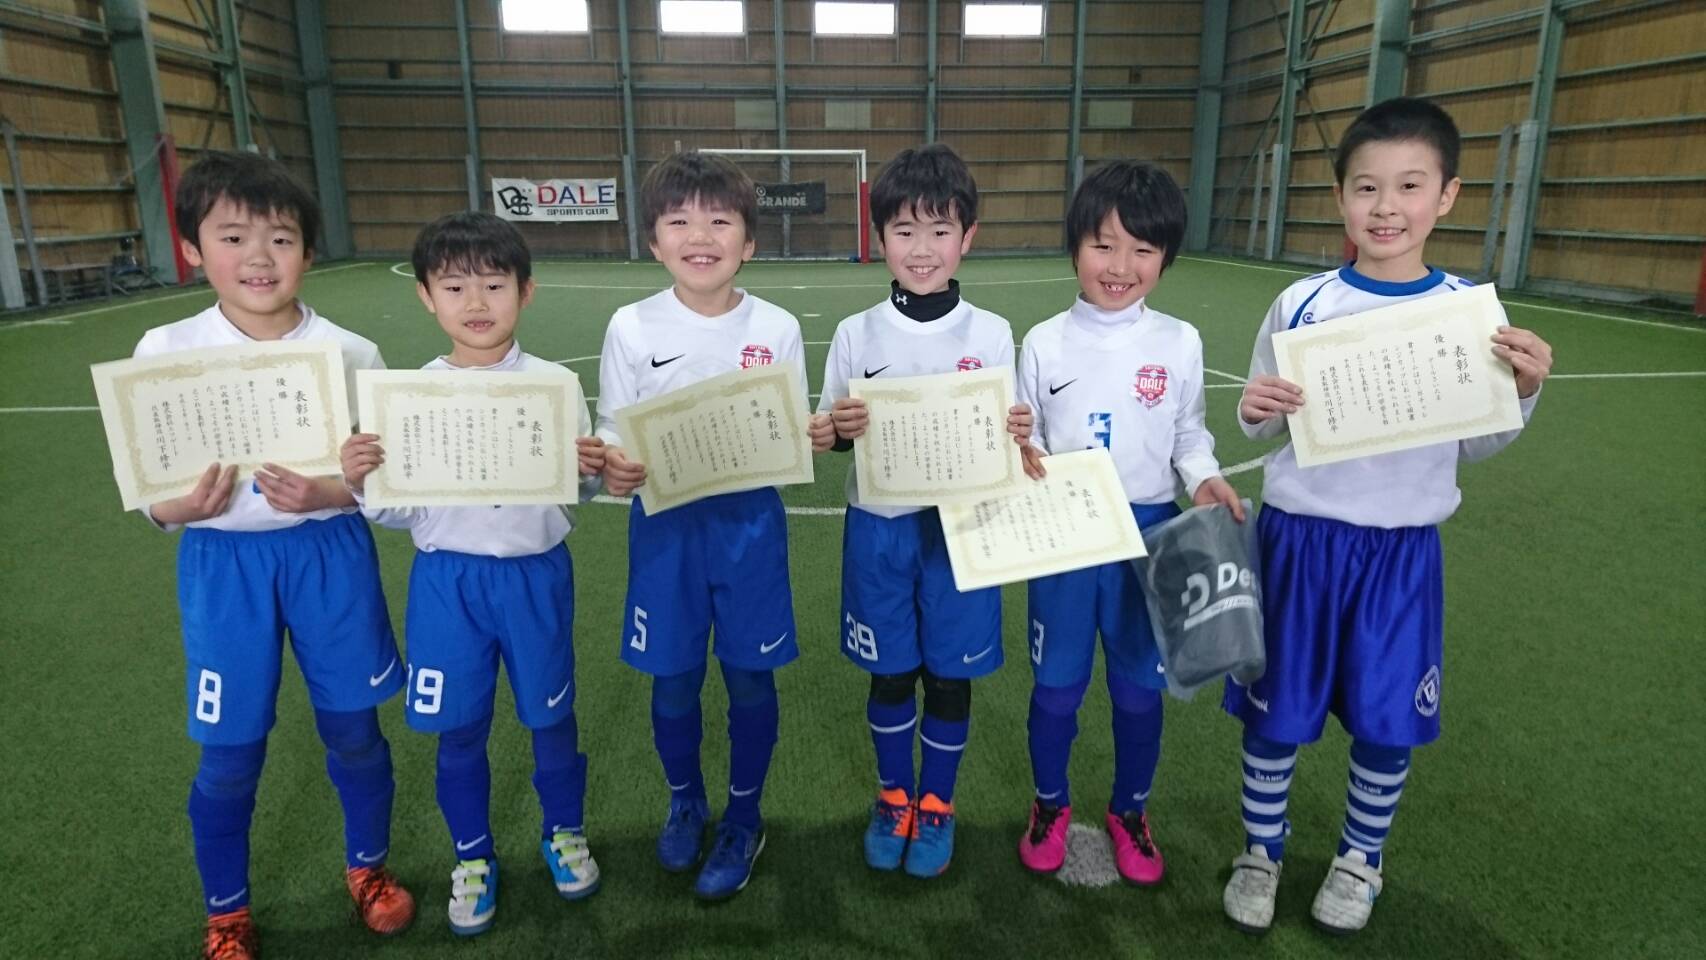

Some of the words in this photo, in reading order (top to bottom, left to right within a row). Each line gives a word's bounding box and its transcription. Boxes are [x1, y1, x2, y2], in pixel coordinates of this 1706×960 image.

[538, 185, 615, 204] DALE
[757, 196, 807, 207] GRANDE
[547, 208, 583, 216] SPORTS
[1434, 334, 1447, 358] 優勝
[1452, 345, 1472, 384] 表彰状
[276, 377, 288, 400] 優勝
[1139, 377, 1164, 391] DALE
[295, 390, 311, 428] 表彰状
[516, 407, 526, 429] 優勝
[765, 409, 782, 441] 表彰状
[529, 420, 544, 457] 表彰状
[984, 415, 997, 452] 表彰状
[1082, 488, 1101, 520] 表彰状
[630, 606, 648, 652] 5
[846, 611, 879, 662] 39
[1032, 619, 1045, 666] 3
[196, 668, 222, 724] 8
